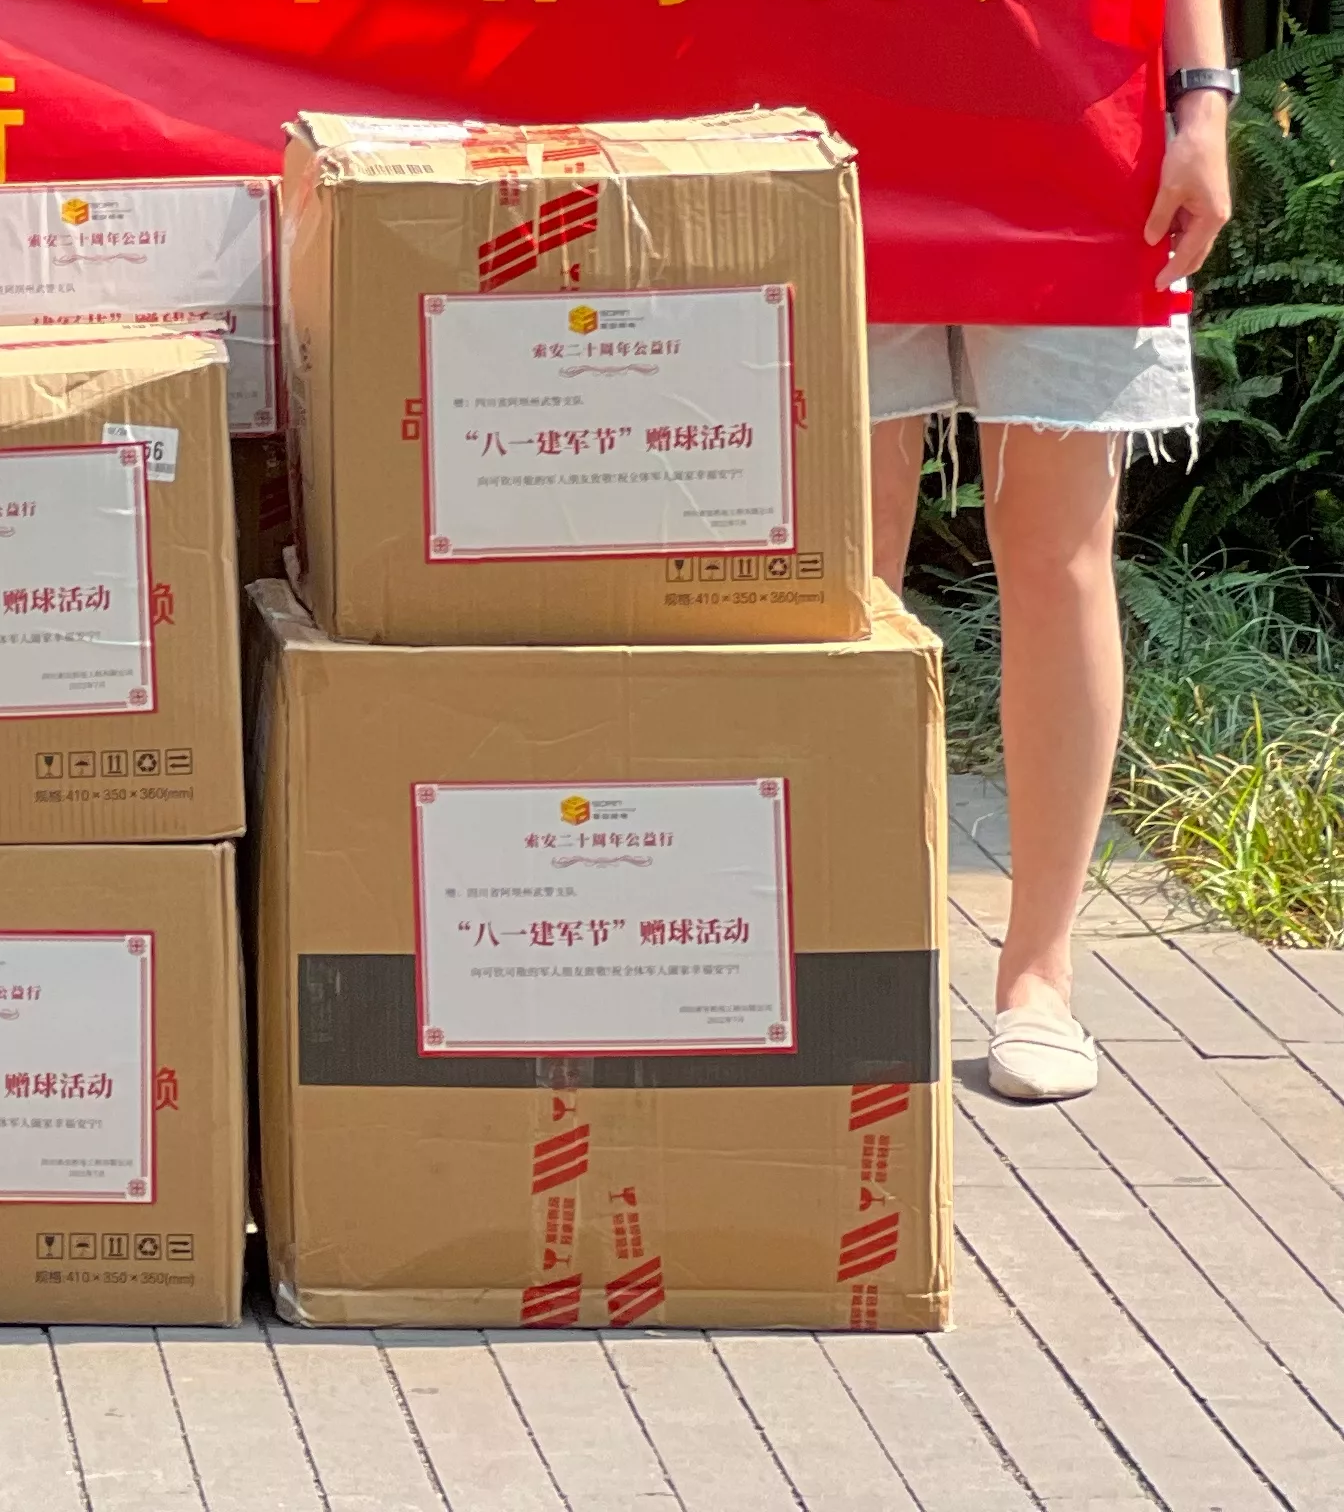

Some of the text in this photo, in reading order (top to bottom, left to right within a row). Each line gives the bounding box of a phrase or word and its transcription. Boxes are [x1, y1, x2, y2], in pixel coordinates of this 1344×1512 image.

[531, 339, 680, 358] 索安二十周年公益行
[523, 831, 673, 848] 索安二十周年公益行
